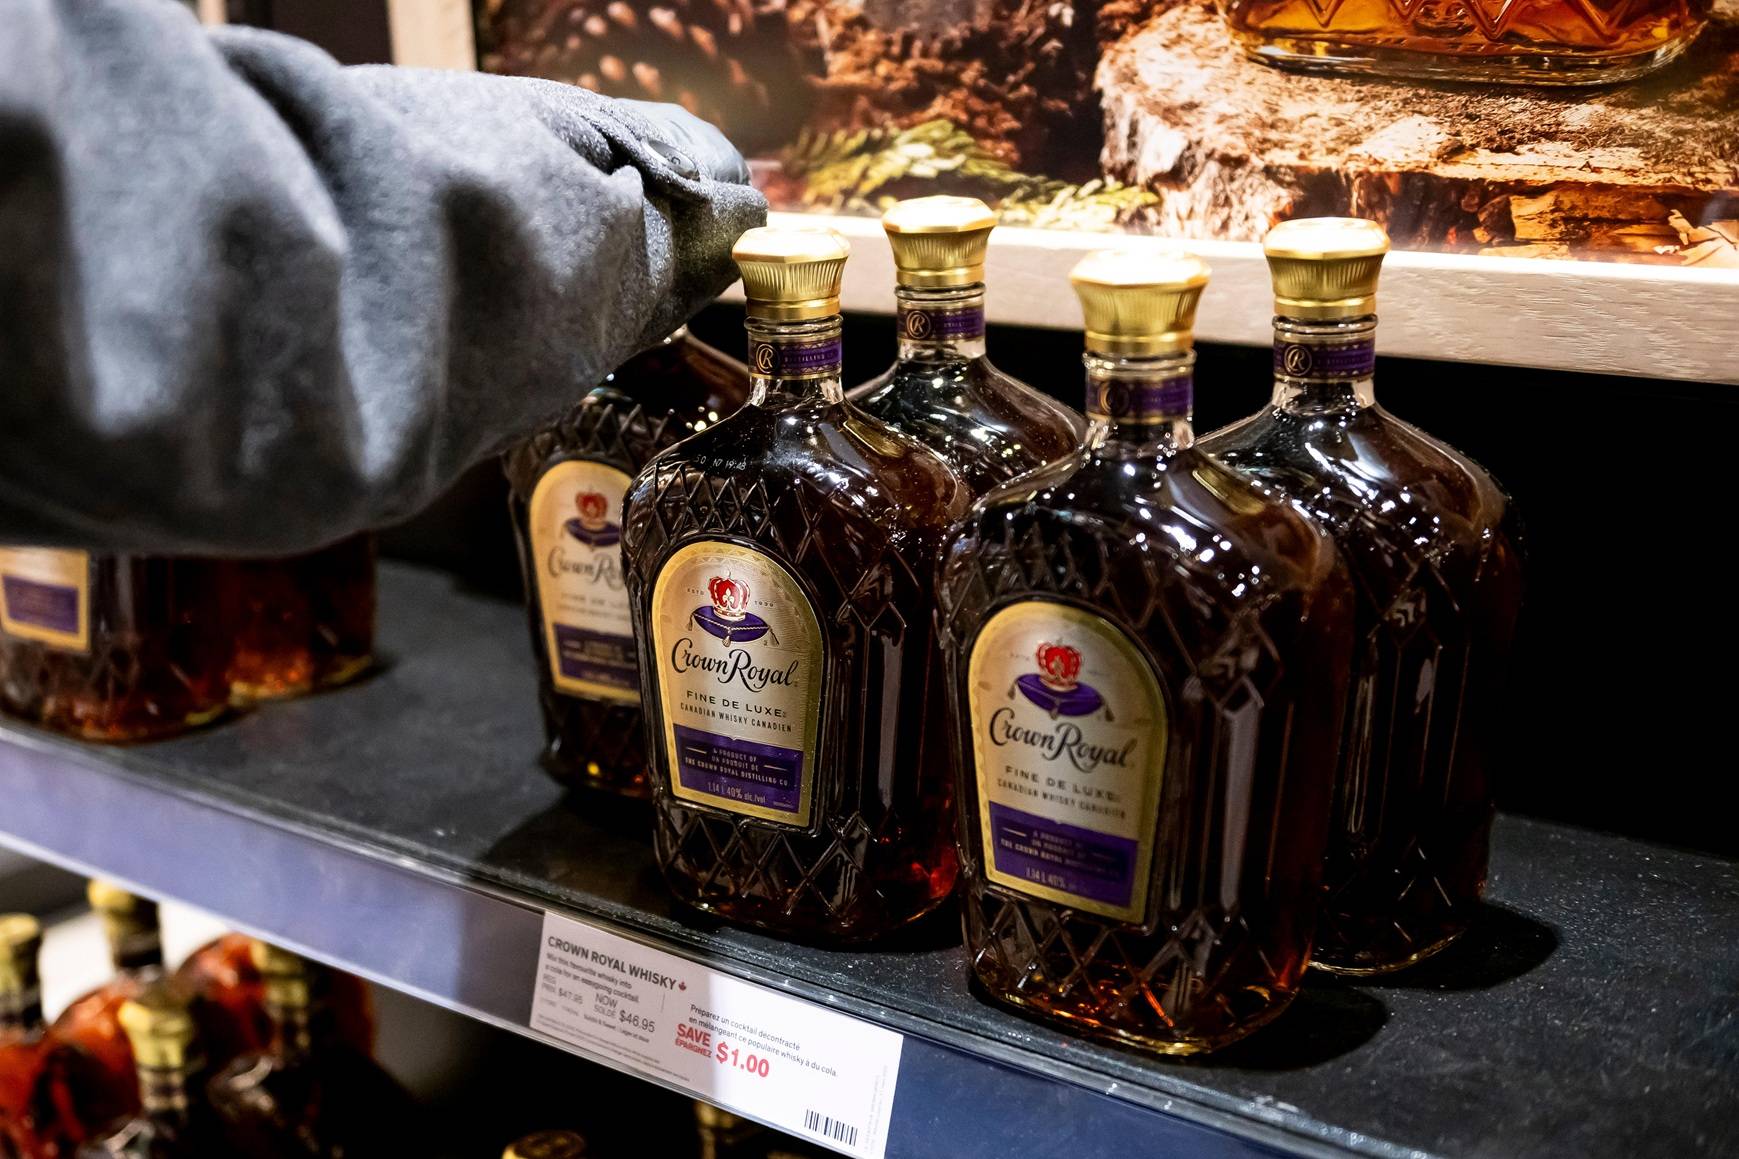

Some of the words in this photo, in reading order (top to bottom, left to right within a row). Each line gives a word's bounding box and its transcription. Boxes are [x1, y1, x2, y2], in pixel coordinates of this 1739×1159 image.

[671, 637, 728, 674] Crown
[718, 649, 799, 693] Royal
[680, 702, 715, 718] CANADIAN
[718, 711, 747, 725] WHISKY
[751, 718, 793, 734] CANADIEN
[687, 690, 716, 704] FINE
[722, 699, 740, 710] DE
[746, 704, 782, 718] LUXE
[989, 706, 1055, 750] Crown
[1042, 722, 1138, 774] Royal
[740, 770, 777, 785] DISTILLING
[1004, 765, 1039, 783] FINE
[1046, 777, 1066, 791] DE
[548, 936, 590, 960] CROWN
[591, 950, 627, 973] ROYAL
[629, 964, 677, 990] WHISKY
[595, 993, 619, 1009] NOW
[618, 1010, 656, 1034] $46.95
[677, 1023, 712, 1047] SAVE
[721, 1016, 730, 1025] un
[730, 1020, 758, 1036] cocktail
[716, 1041, 770, 1078] $1.00
[738, 1034, 748, 1043] ce
[747, 1038, 781, 1056] populaire
[780, 1049, 805, 1067] whisky
[811, 1061, 821, 1072] du
